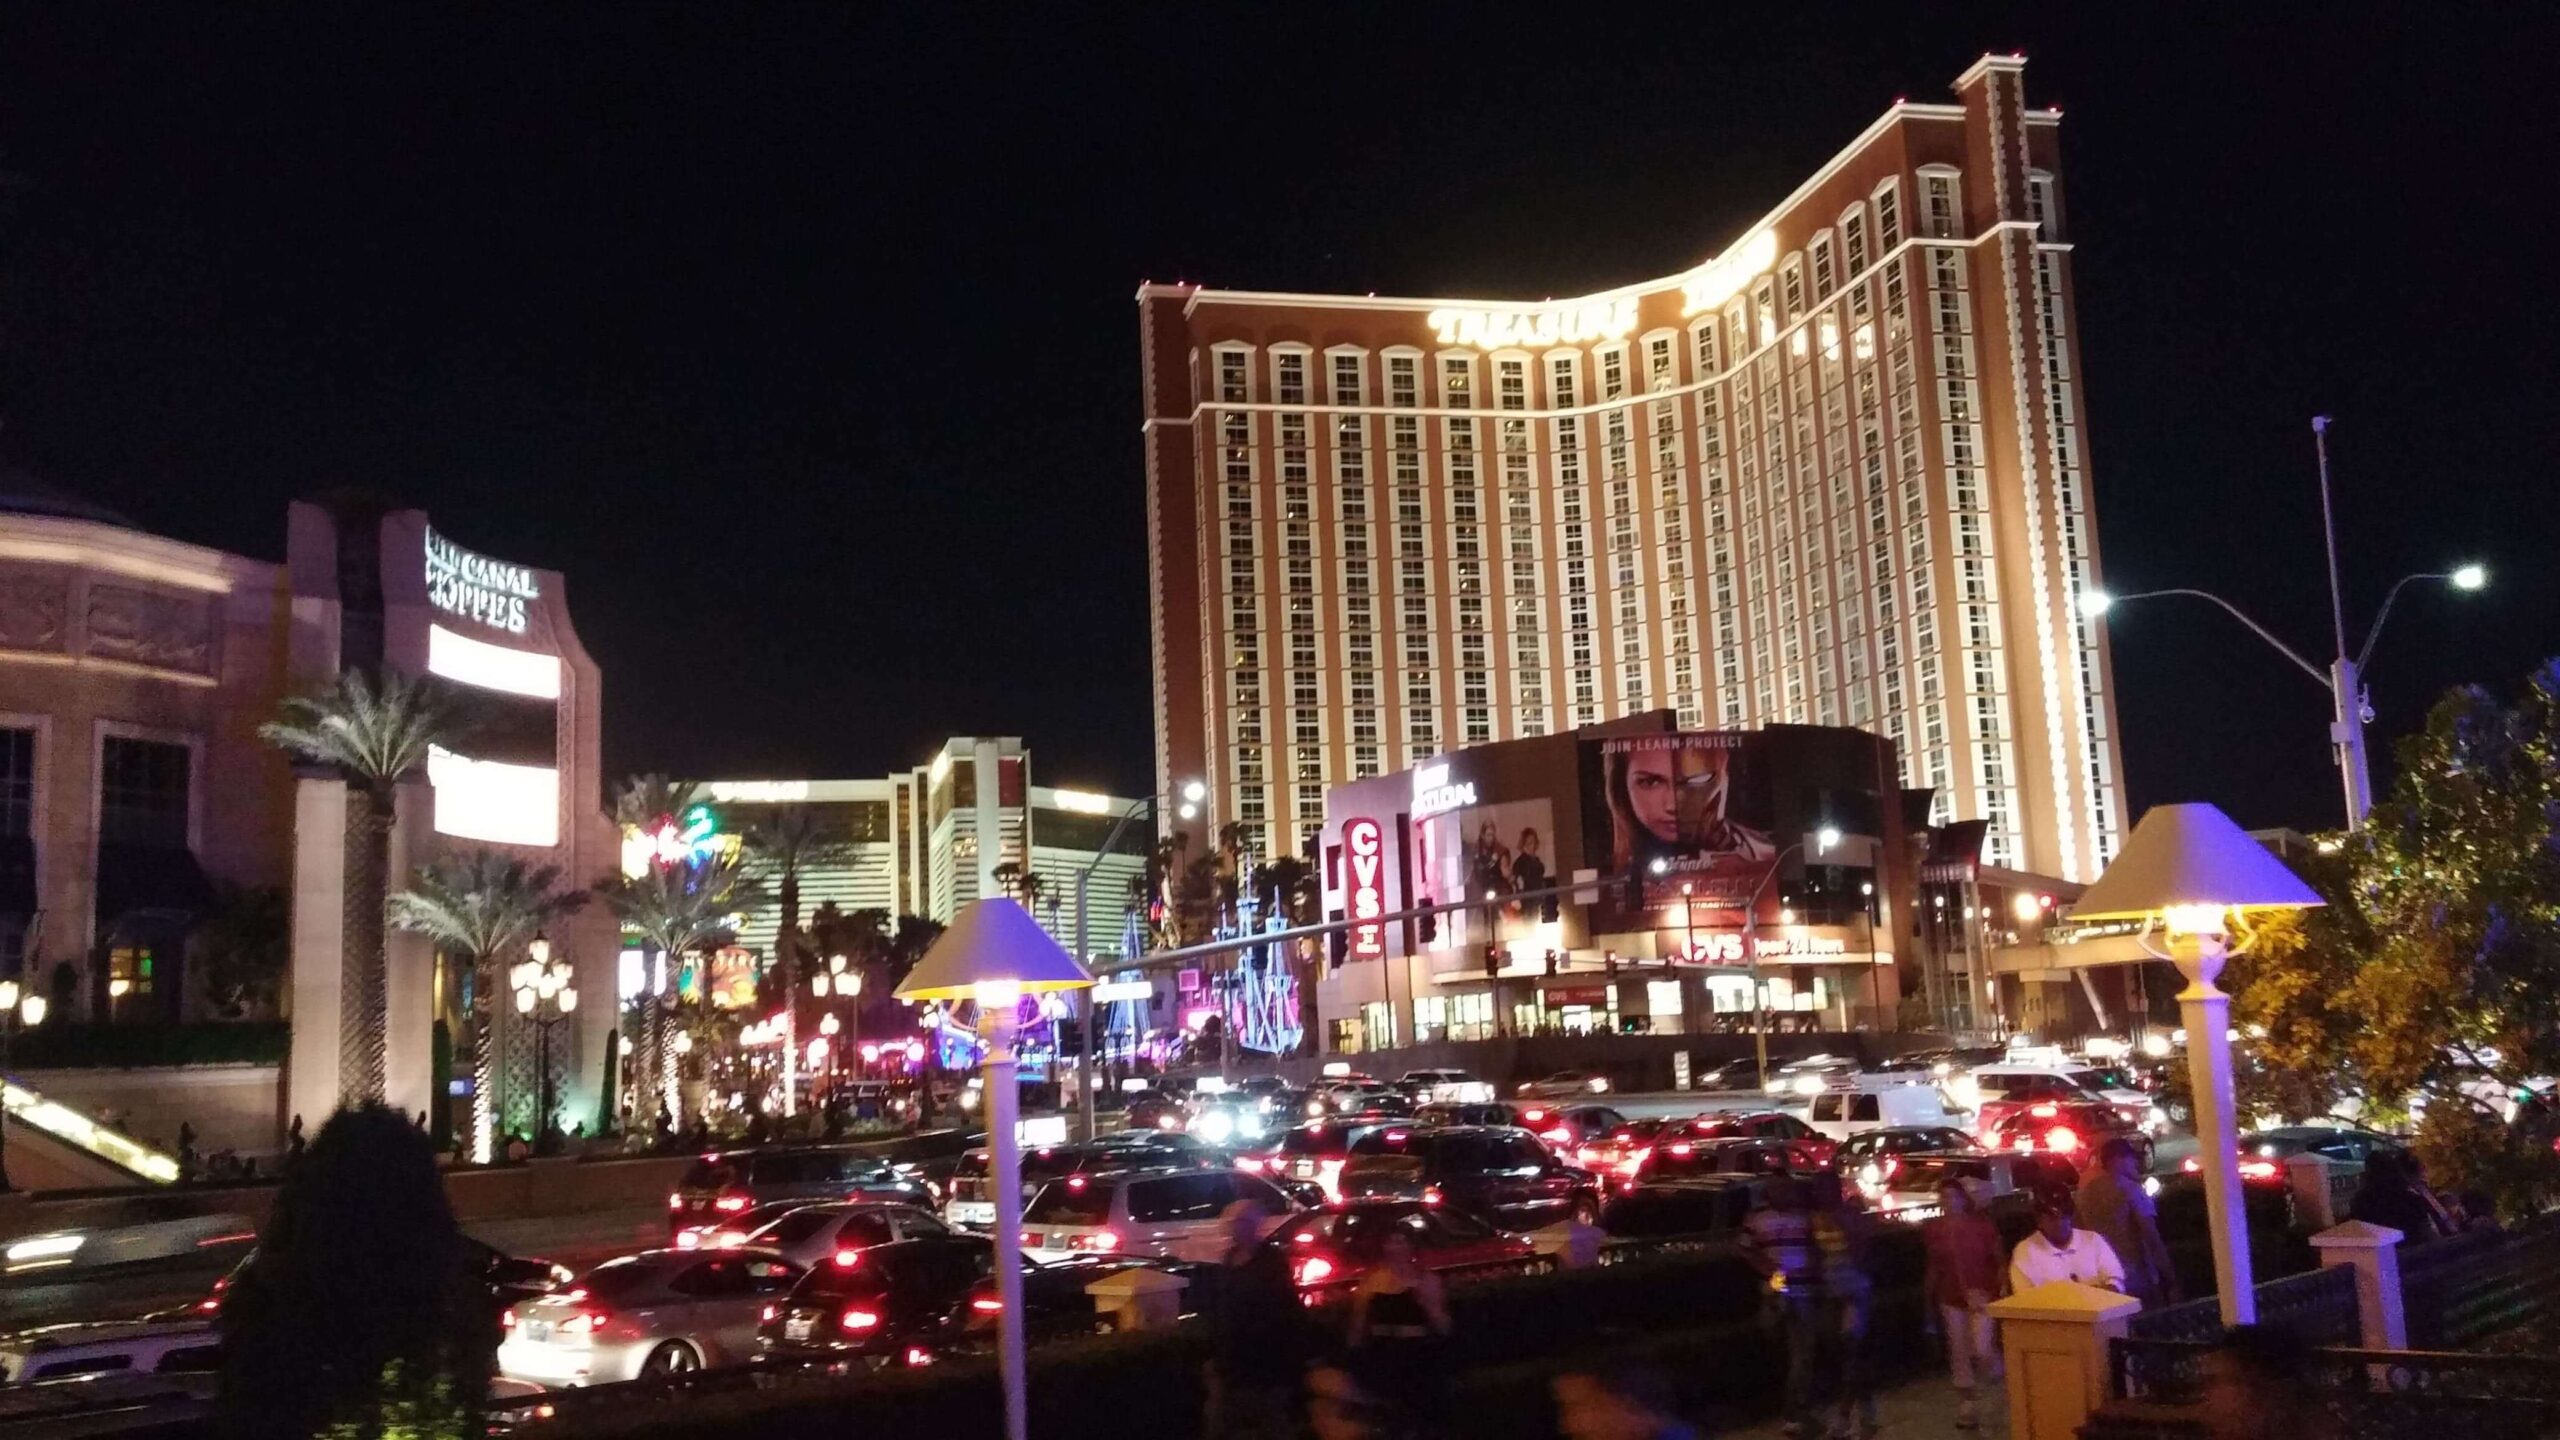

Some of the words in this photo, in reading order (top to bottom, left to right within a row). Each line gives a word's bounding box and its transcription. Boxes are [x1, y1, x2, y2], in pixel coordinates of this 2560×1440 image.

[1601, 740, 1631, 754] JOIN
[1636, 738, 1680, 751] LEARN
[1685, 735, 1743, 749] PROTECT
[1351, 822, 1380, 919] CVS
[1681, 933, 1744, 961] CVS
